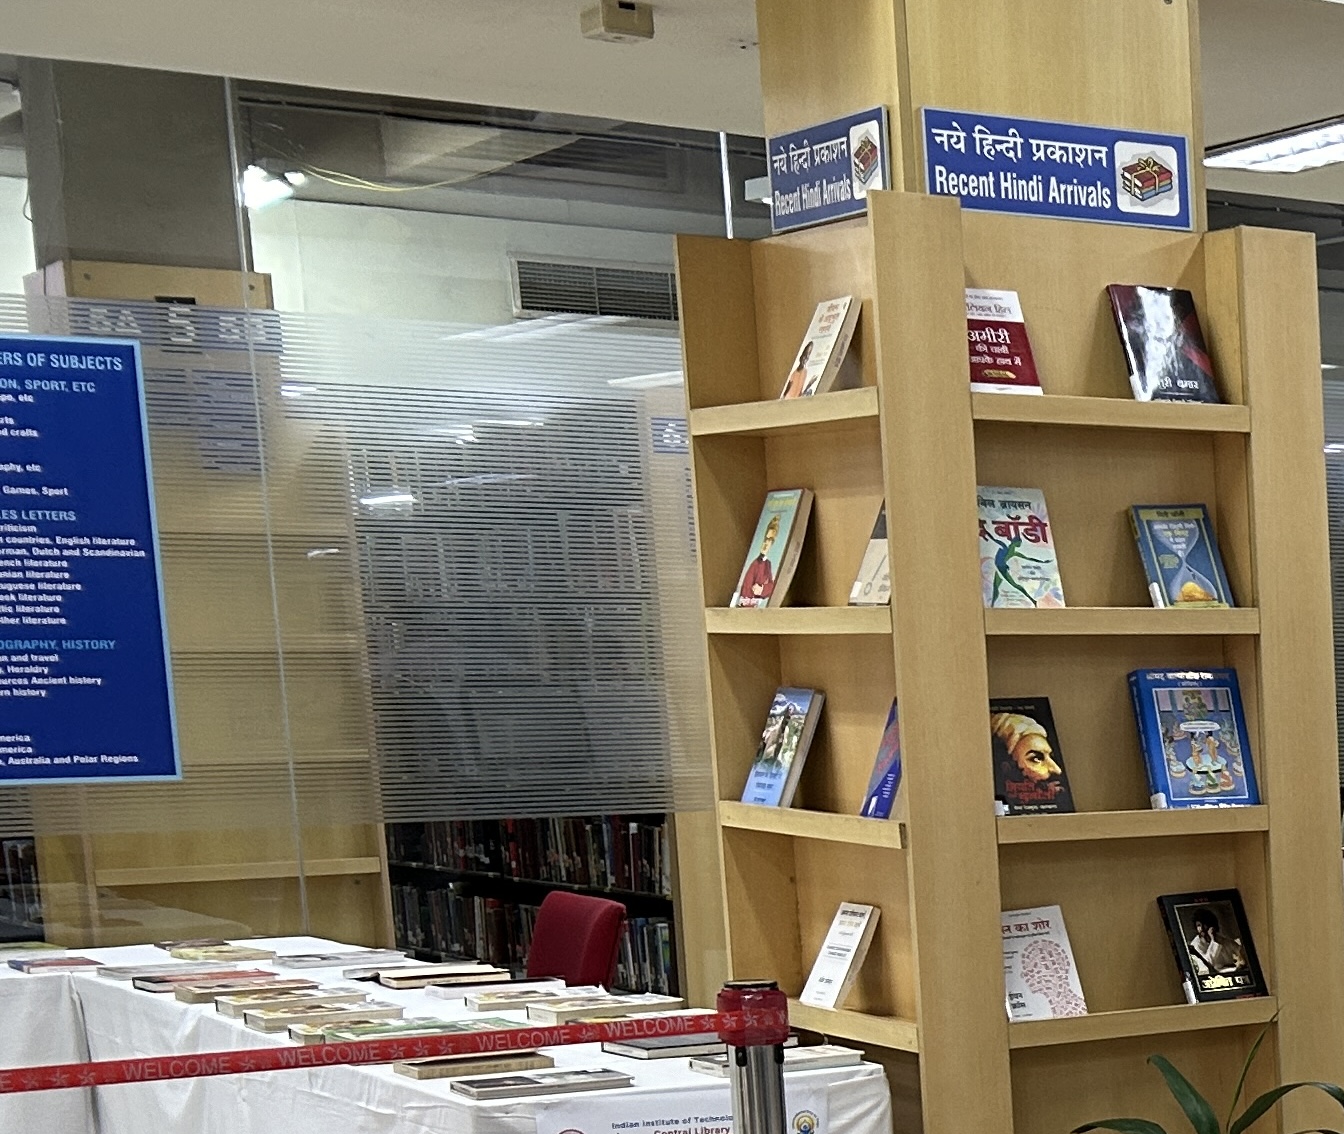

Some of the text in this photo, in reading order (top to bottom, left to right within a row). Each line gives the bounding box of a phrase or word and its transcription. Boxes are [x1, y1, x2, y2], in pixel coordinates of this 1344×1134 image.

[931, 121, 1108, 168] नये हिन्दी प्रकाशन
[772, 137, 847, 175] नये हिन्दी प्रकाशन
[935, 165, 1111, 209] Recent Hindi Arrivals
[775, 174, 851, 216] Recent Hindi Arrivals
[27, 353, 123, 371] OF SUBJECTS
[25, 380, 69, 392] SPORT,
[72, 382, 96, 393] ETC
[18, 394, 34, 402] etc
[26, 464, 42, 472] etc
[2, 486, 69, 496] Games, Sport
[22, 510, 77, 521] LETTERS
[55, 536, 90, 546] English
[92, 537, 136, 546] literature
[32, 548, 146, 557] Dutch and Scandinavian
[24, 559, 68, 567] literature
[26, 571, 70, 579] literature
[38, 582, 81, 590] literature
[16, 605, 60, 613] literature
[22, 617, 66, 625] literature
[62, 640, 116, 649] HISTORY
[11, 654, 59, 662] and travel
[7, 665, 49, 674] Heraldry
[31, 677, 102, 685] Ancient history
[13, 688, 47, 697] history
[8, 757, 51, 765] Australia
[101, 755, 138, 764] Regions
[603, 1015, 696, 1037] WELCOME
[476, 1030, 571, 1051] WELCOME
[276, 1043, 381, 1066] WELCOME
[122, 1056, 231, 1081] WELCOME
[642, 1118, 680, 1127] Institute
[682, 1117, 691, 1125] of
